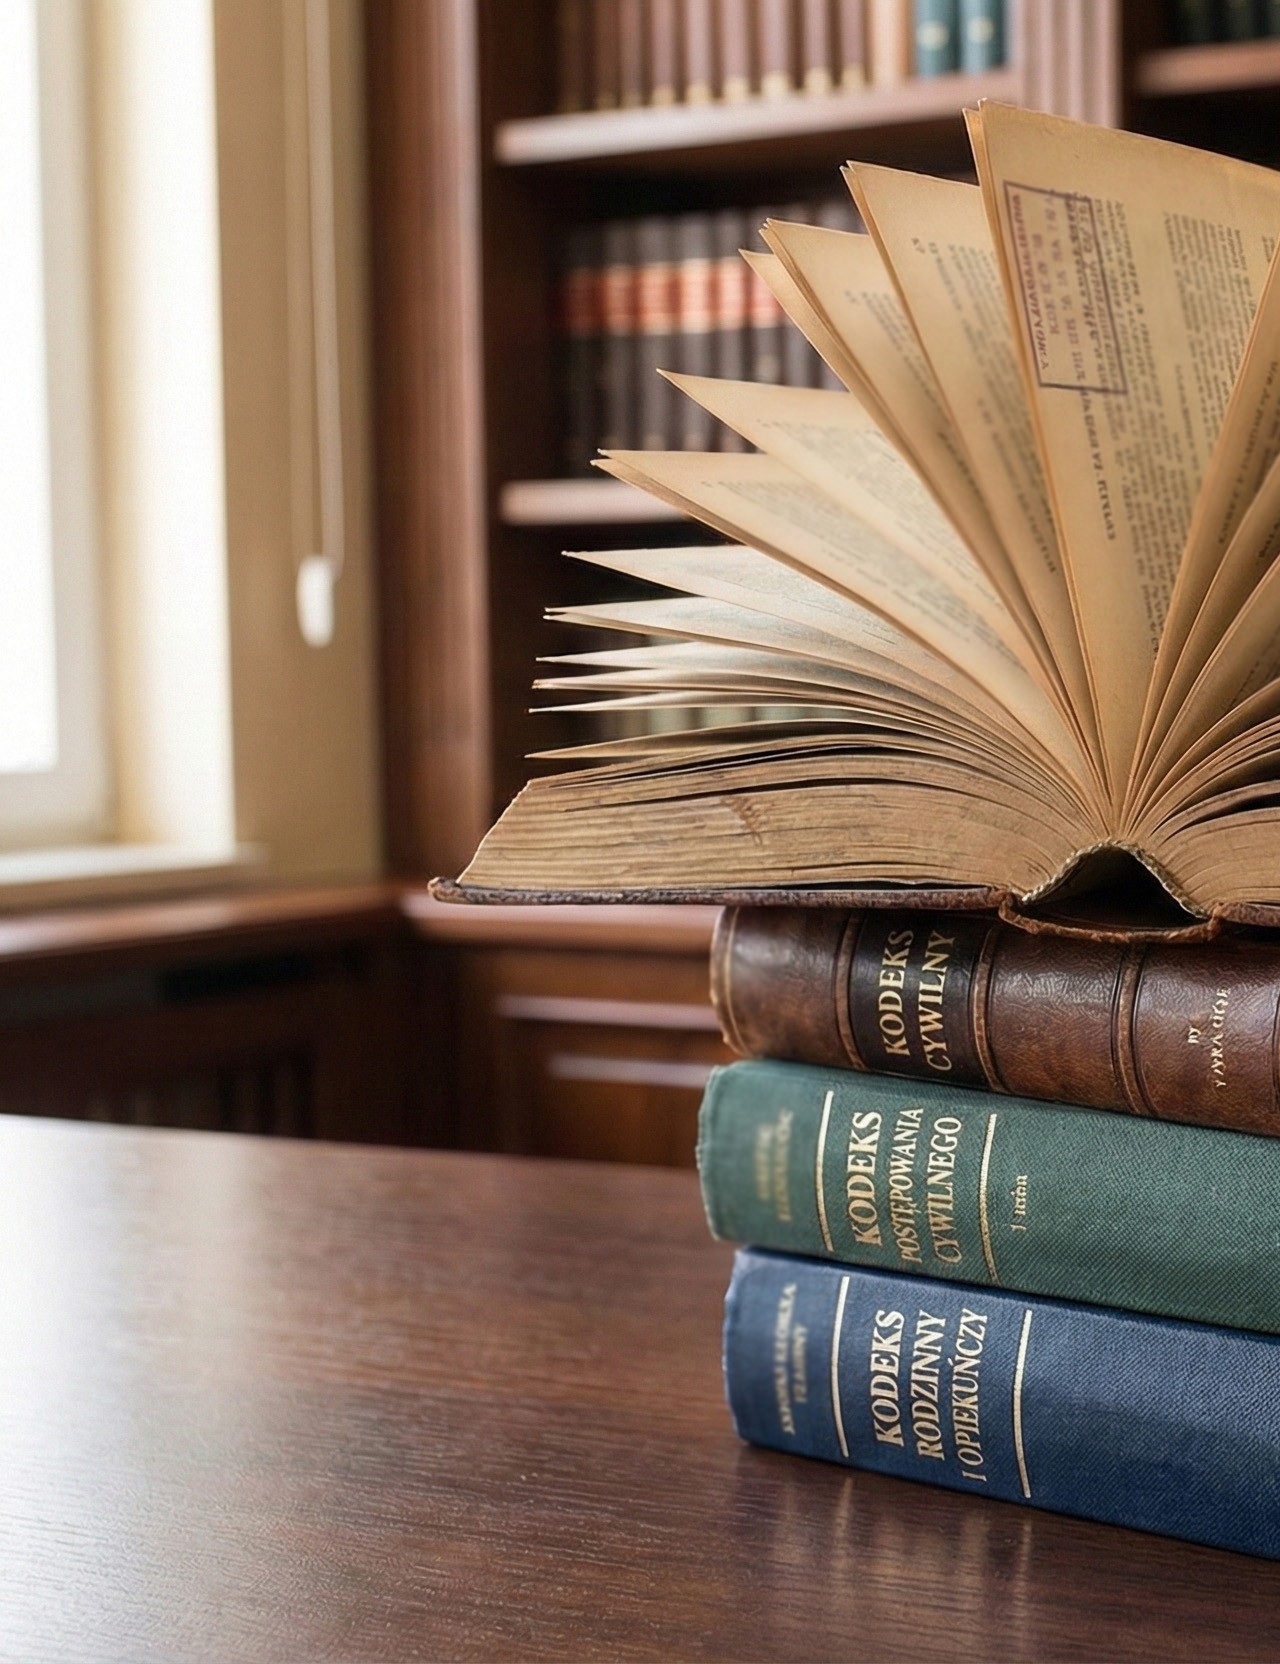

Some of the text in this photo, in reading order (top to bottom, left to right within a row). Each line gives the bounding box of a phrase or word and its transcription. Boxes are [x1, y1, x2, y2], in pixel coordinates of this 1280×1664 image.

[878, 930, 914, 1056] KODEKS
[918, 931, 956, 1071] CYWILNY
[847, 1111, 882, 1246] KODEKS
[889, 1108, 924, 1263] POSTĘPOWANIA
[926, 1116, 962, 1263] CYWILNEGO
[870, 1309, 905, 1447] KODEKS
[910, 1309, 946, 1461] RODZINNY
[947, 1308, 988, 1482] I OPIEKUŃCZY
